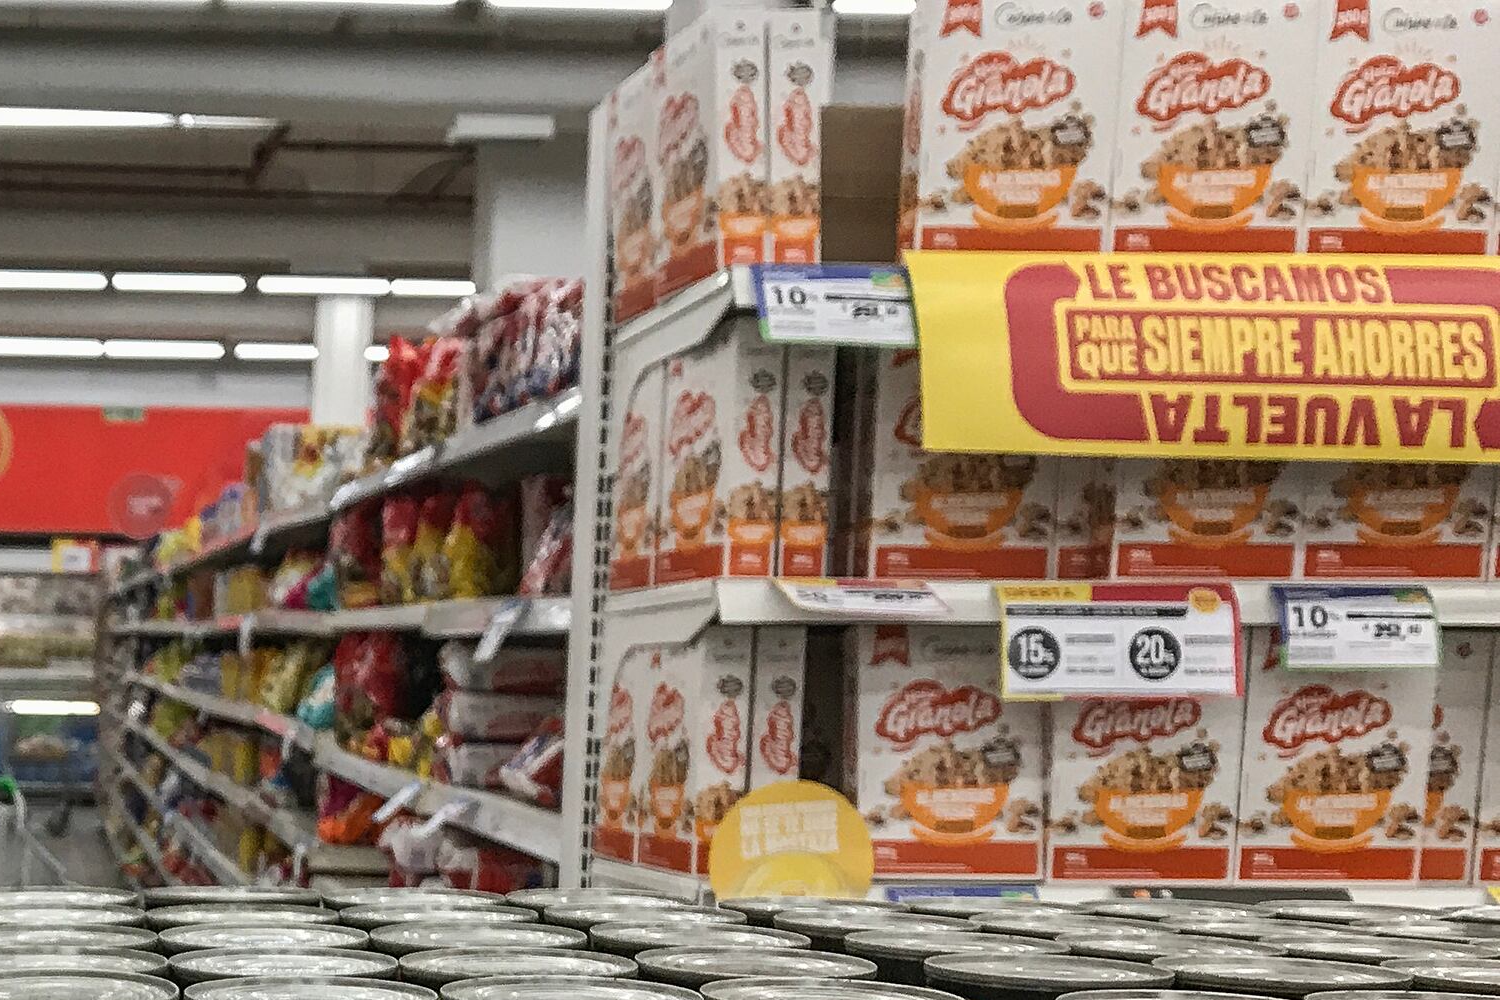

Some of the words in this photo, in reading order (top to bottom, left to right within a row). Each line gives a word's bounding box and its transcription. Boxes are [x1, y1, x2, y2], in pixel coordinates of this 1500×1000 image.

[952, 63, 1071, 119] Granola
[1146, 65, 1264, 118] Granola
[1341, 69, 1454, 119] Granola
[1085, 263, 1136, 299] LE
[1144, 264, 1387, 303] BUSCAMOS
[1074, 315, 1136, 341] PARA
[1140, 316, 1304, 377] SIEMPRE
[1313, 319, 1489, 381] AHORRES
[1078, 343, 1137, 377] QUE
[1148, 393, 1381, 447] VUELTA
[1393, 396, 1468, 448] LA
